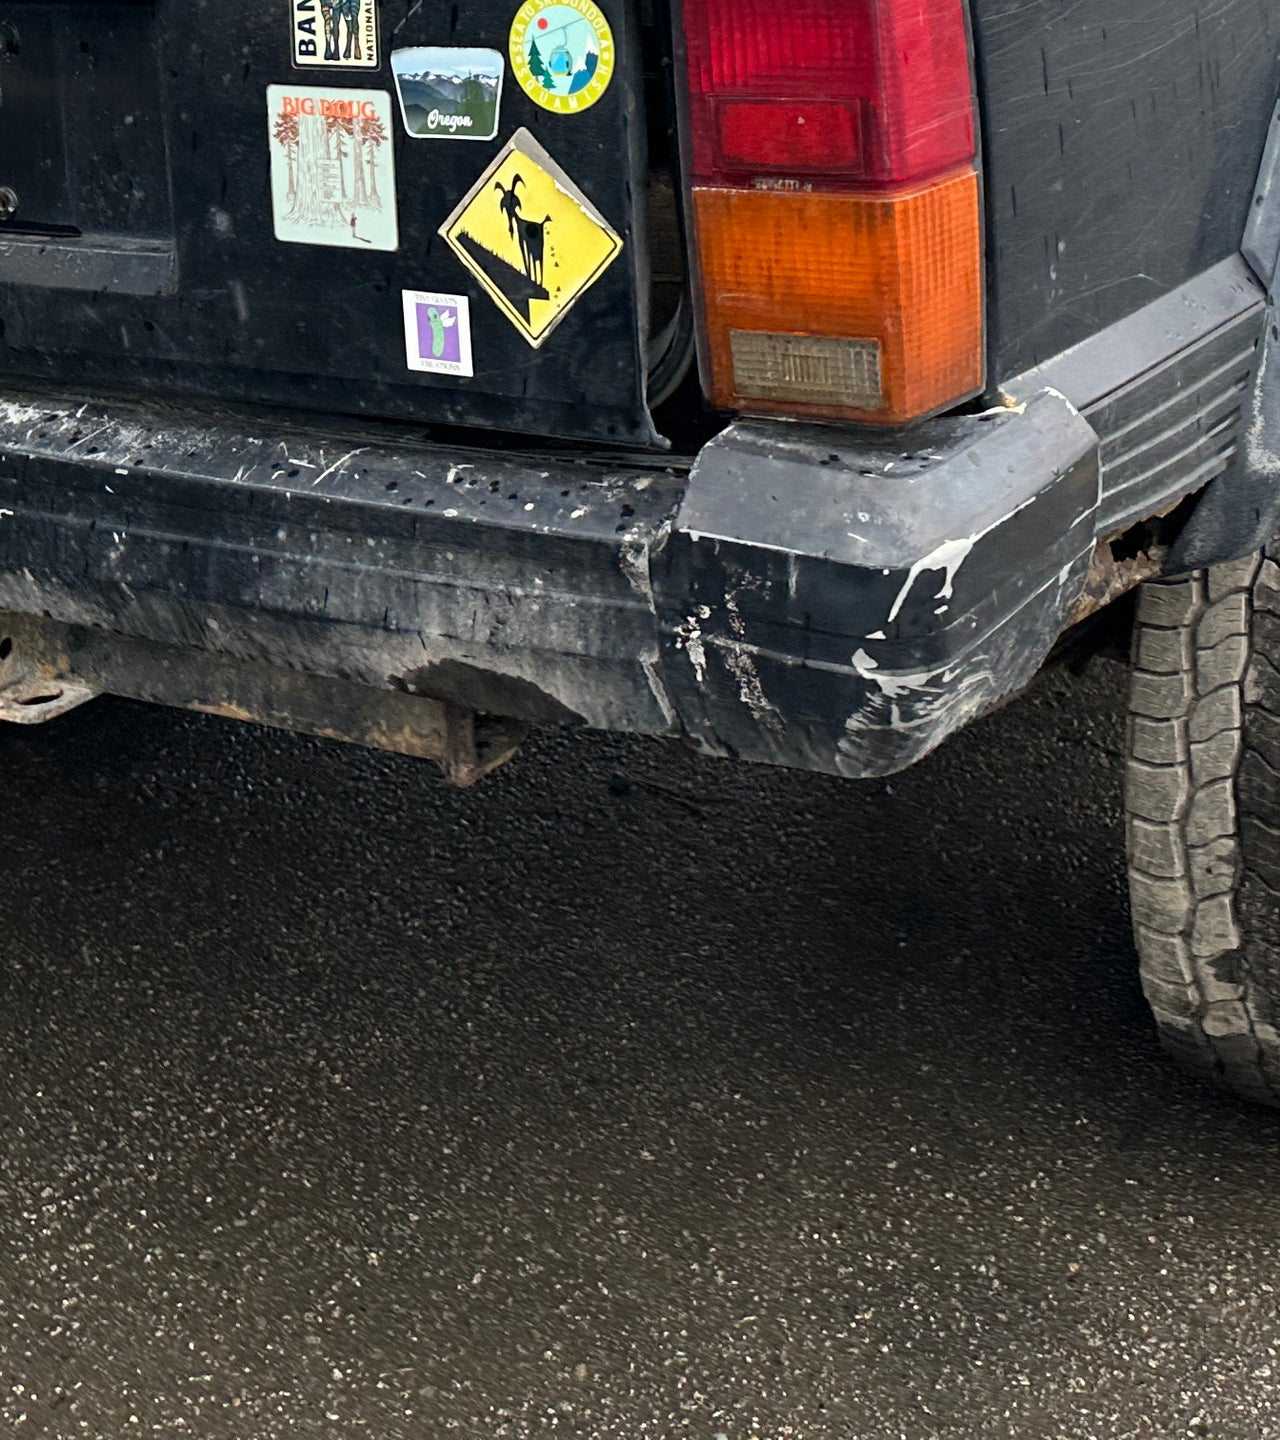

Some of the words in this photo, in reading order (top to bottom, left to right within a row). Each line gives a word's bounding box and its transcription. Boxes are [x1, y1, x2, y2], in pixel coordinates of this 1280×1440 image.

[364, 1, 375, 61] NATIONAL
[512, 23, 527, 52] SEA
[520, 5, 535, 21] TO
[282, 96, 315, 116] BIG
[320, 98, 377, 120] DOUG
[517, 65, 609, 110] SQUAMISH
[427, 108, 473, 133] Oregon
